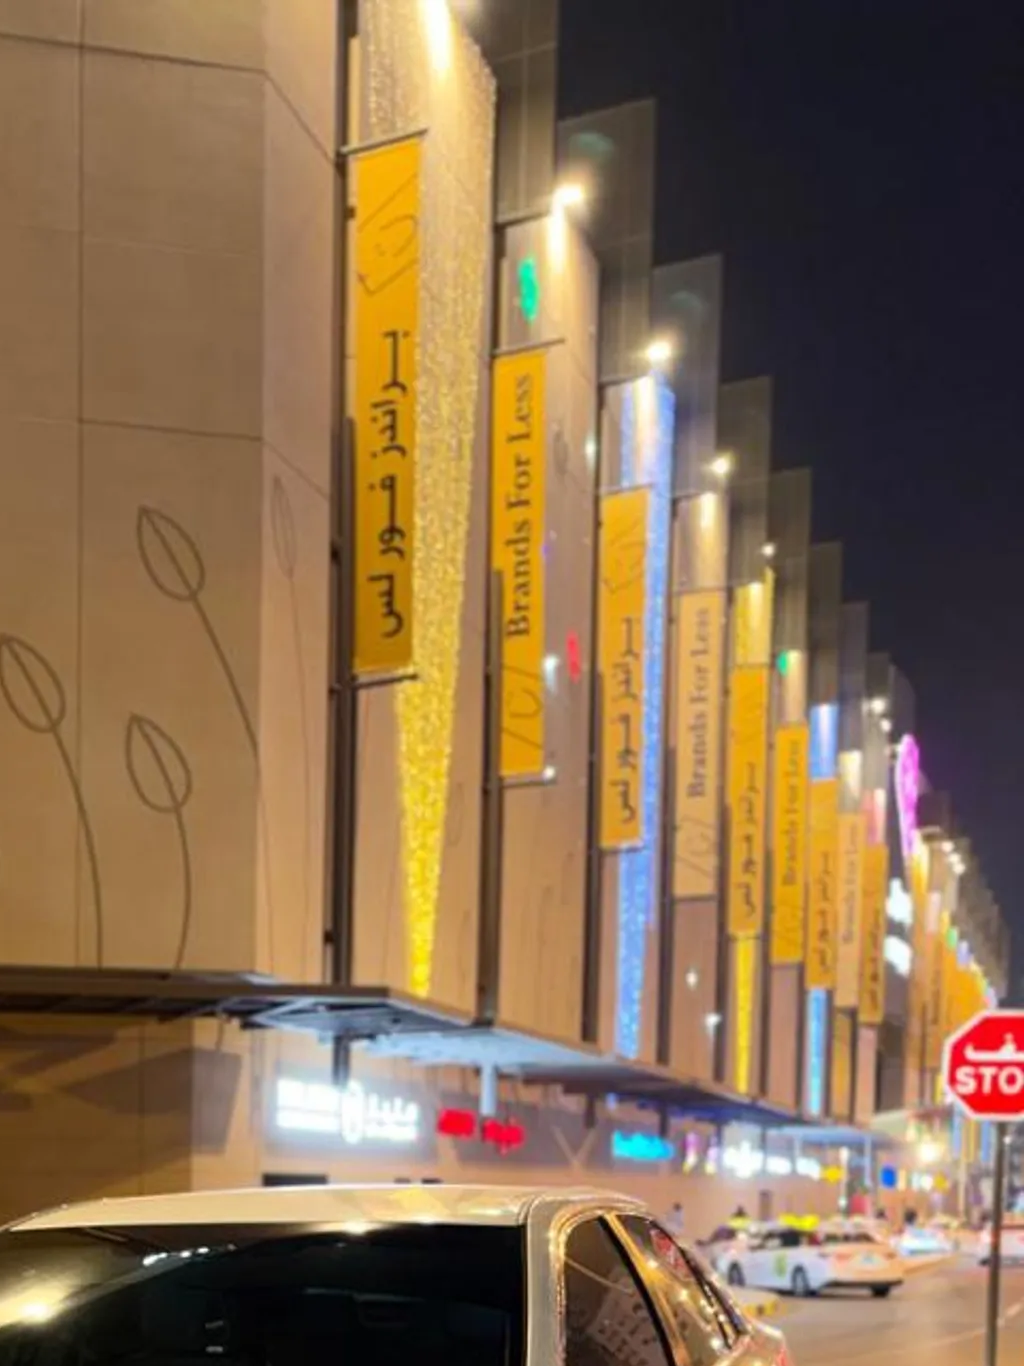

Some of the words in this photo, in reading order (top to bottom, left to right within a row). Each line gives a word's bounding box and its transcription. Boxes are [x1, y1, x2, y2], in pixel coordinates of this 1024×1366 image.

[506, 373, 532, 444] Less
[368, 473, 406, 561] فور
[506, 452, 532, 512] For
[505, 518, 532, 638] Brands
[955, 1065, 1024, 1095] STO
